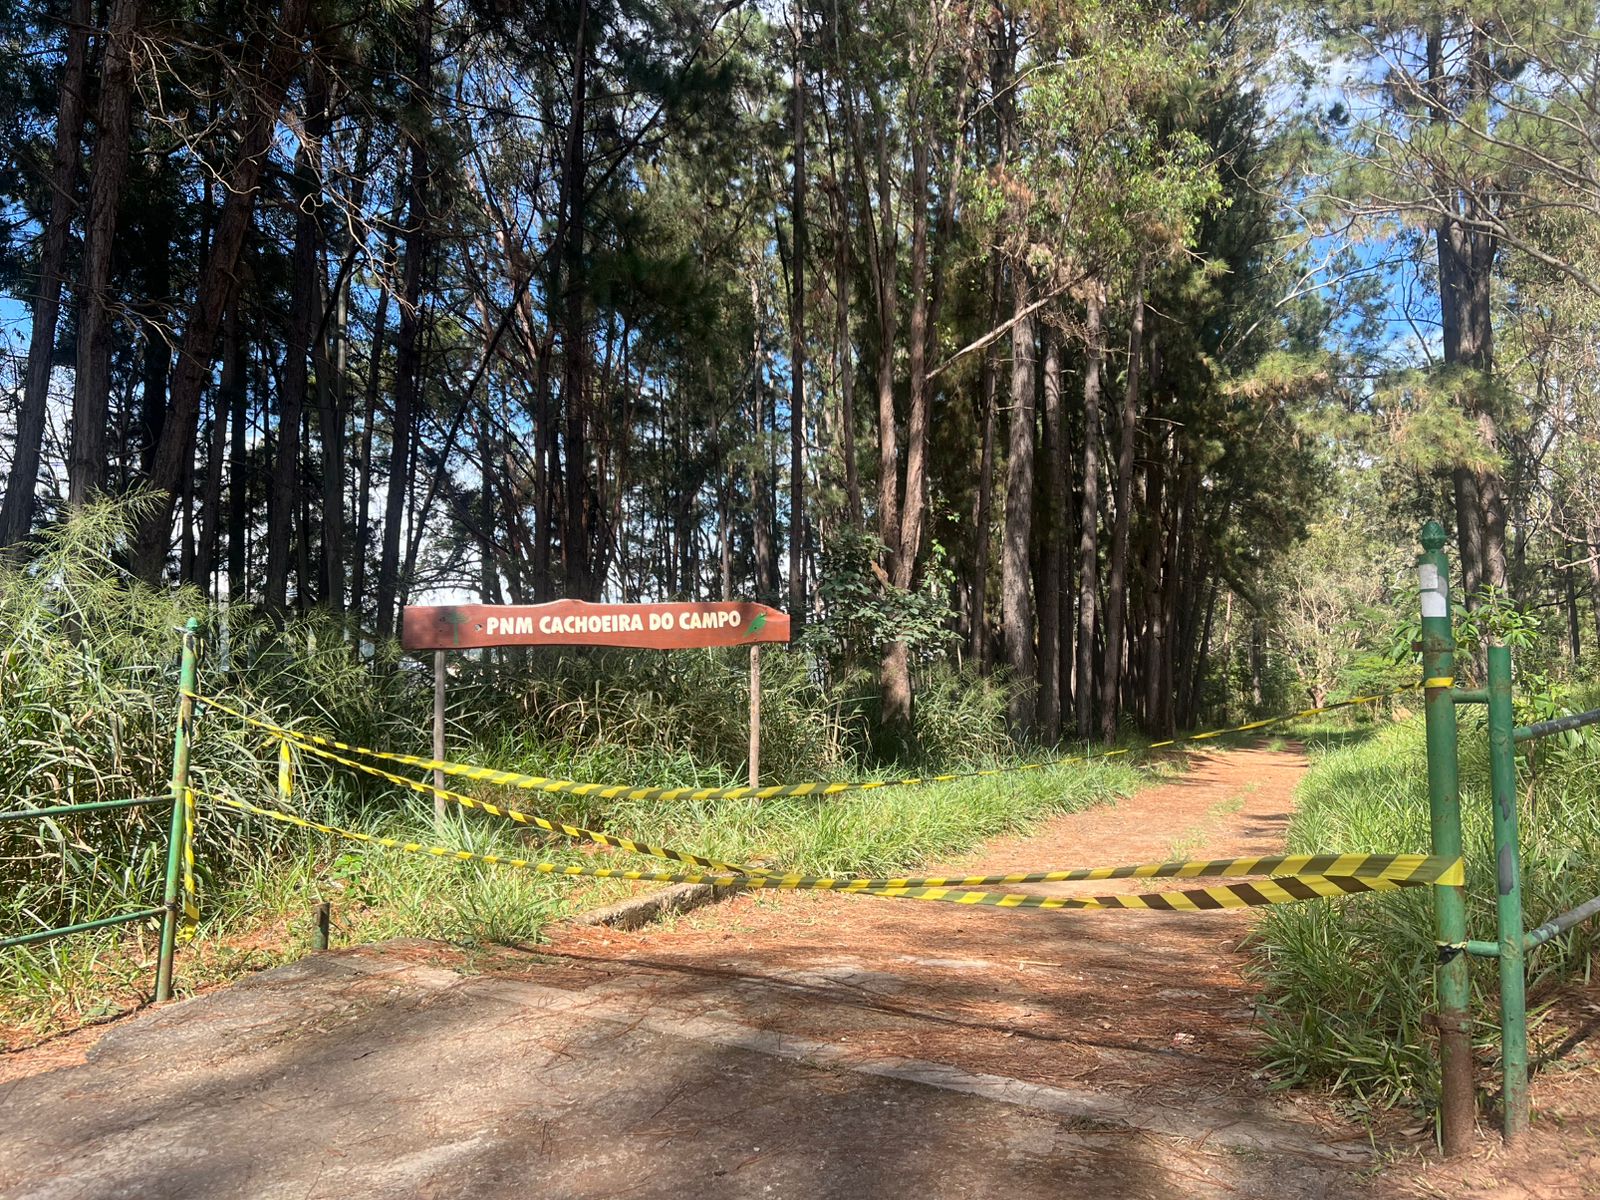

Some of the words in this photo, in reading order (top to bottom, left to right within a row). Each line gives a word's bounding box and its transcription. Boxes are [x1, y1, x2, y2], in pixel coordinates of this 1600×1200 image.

[486, 615, 534, 636] PNM
[539, 613, 642, 634] CACHOEIRA
[649, 613, 674, 632] DO
[679, 610, 741, 630] CAMPO
